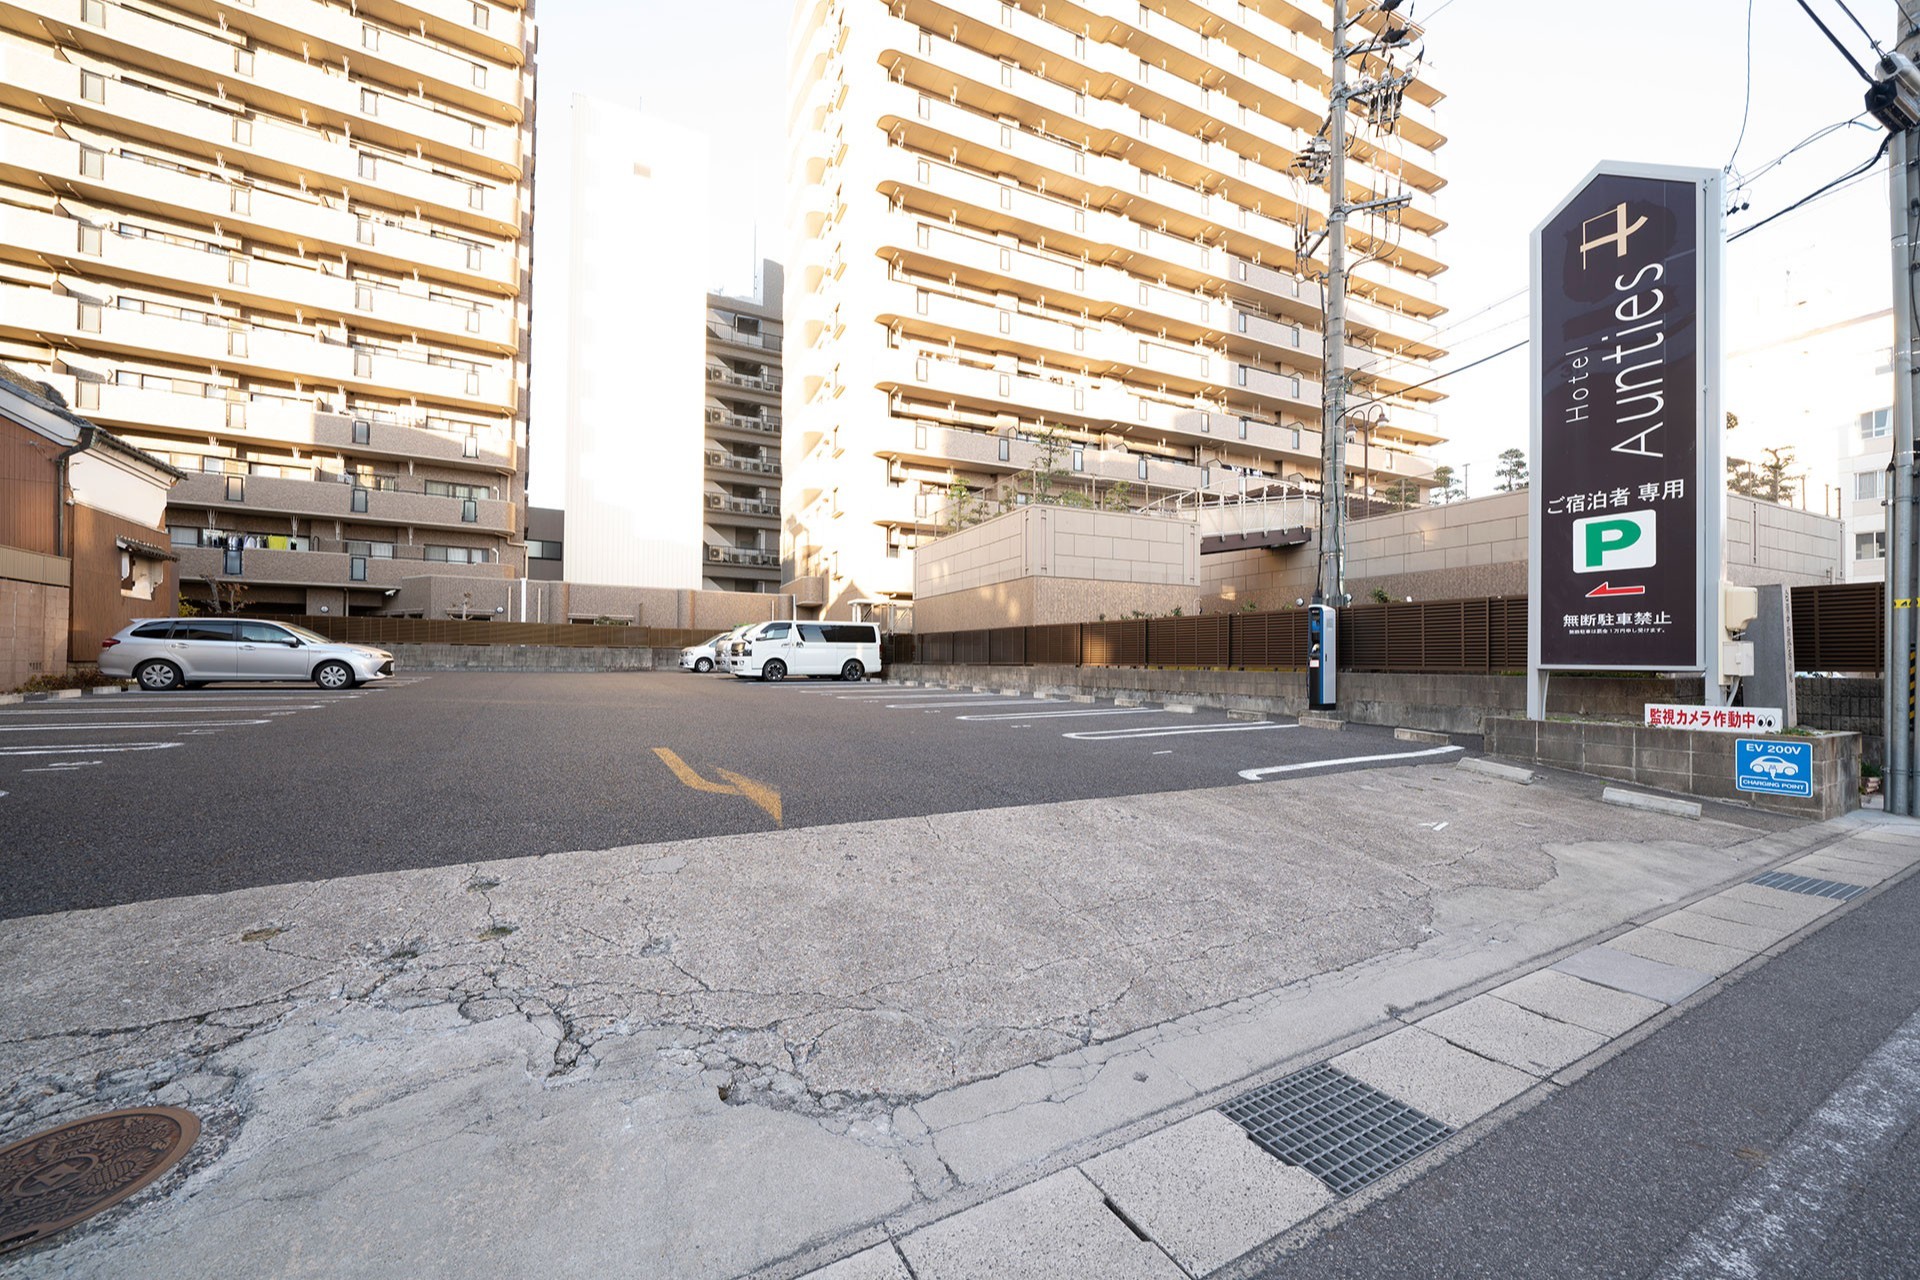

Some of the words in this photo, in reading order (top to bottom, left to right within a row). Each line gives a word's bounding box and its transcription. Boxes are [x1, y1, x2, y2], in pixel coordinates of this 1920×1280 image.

[1601, 262, 1665, 458] Aunties
[1565, 346, 1589, 424] Hotel
[1547, 487, 1630, 516] ご宿泊者
[1637, 478, 1685, 502] 専用
[1585, 519, 1642, 568] P
[1563, 610, 1673, 628] 無断駐車禁止
[1649, 708, 1756, 729] 監視カメラ作動中
[1746, 743, 1764, 752] EV
[1767, 744, 1802, 755] 200V
[1742, 779, 1780, 788] CHARGING
[1781, 783, 1805, 791] POINT
